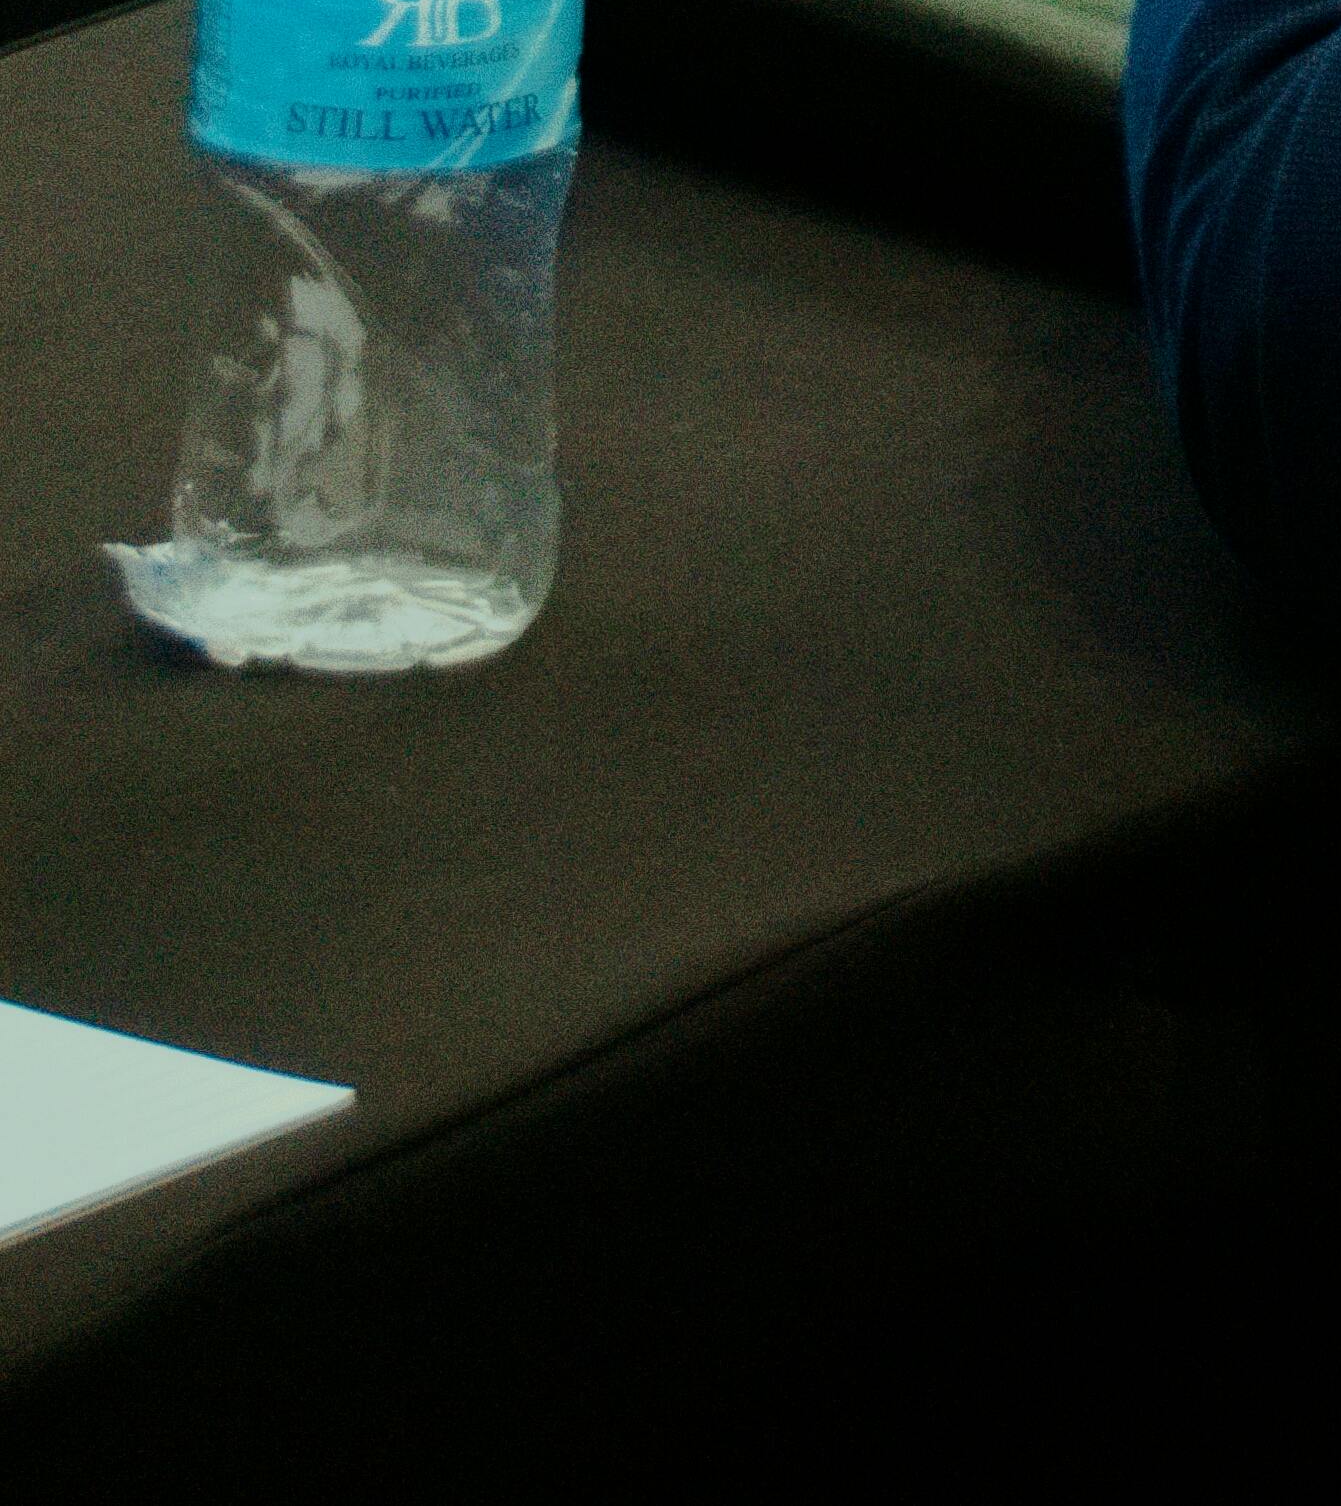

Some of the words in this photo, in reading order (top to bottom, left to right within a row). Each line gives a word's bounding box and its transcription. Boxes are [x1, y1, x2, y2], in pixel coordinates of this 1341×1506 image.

[328, 53, 399, 71] ROYAL
[408, 43, 520, 71] BEVERAGES
[375, 82, 482, 101] PURIFIED
[286, 102, 406, 142] STILL
[420, 92, 542, 138] WATER
